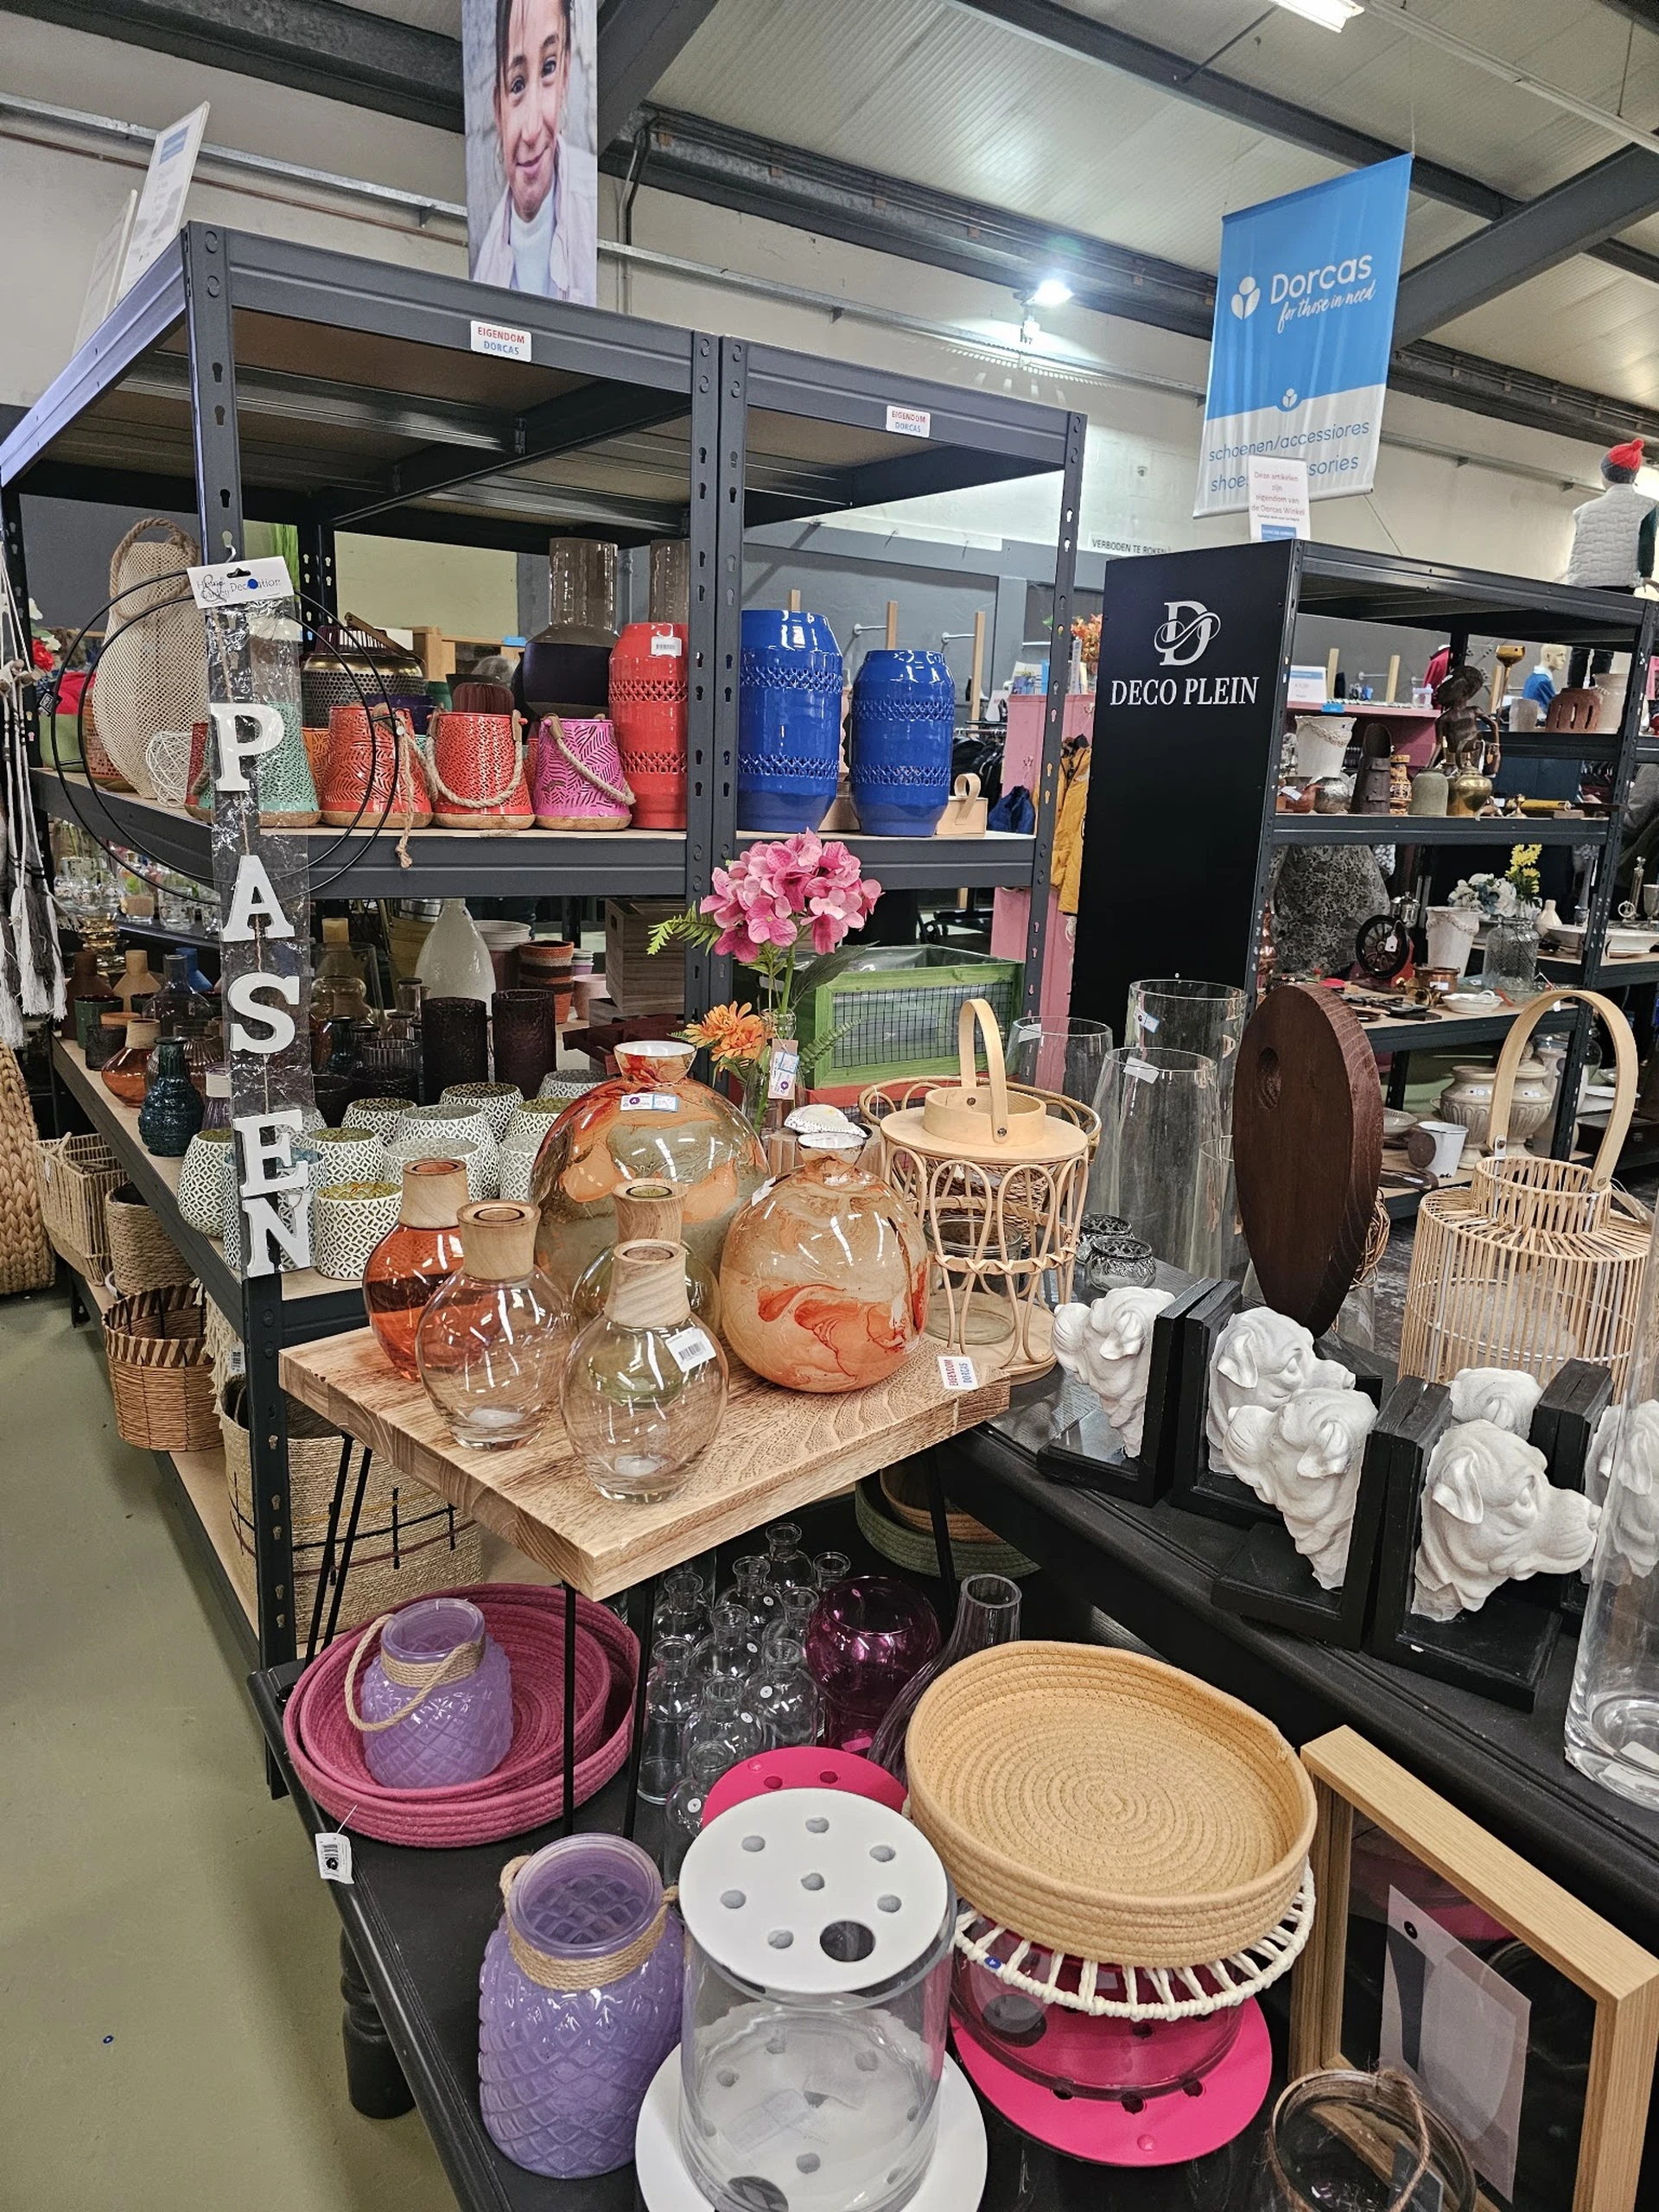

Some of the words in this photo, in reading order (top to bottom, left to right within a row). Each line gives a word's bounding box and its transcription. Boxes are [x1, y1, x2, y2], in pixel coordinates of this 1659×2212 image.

[1270, 255, 1373, 304] Dorcas
[1277, 302, 1296, 334] for
[1298, 297, 1331, 318] those
[1331, 294, 1345, 309] in
[1345, 279, 1376, 305] need
[478, 327, 524, 344] EIGENDOM
[484, 340, 519, 355] DORCAS
[892, 410, 925, 423] EIGENDOM
[895, 422, 921, 433] DORCAS
[1209, 422, 1370, 462] schoenen/accessiores
[1092, 539, 1131, 552] VERBODEN
[1133, 544, 1141, 554] TE
[1109, 678, 1177, 705] DECO
[1183, 677, 1260, 705] PLEIN
[959, 1363, 973, 1383] DORCAS
